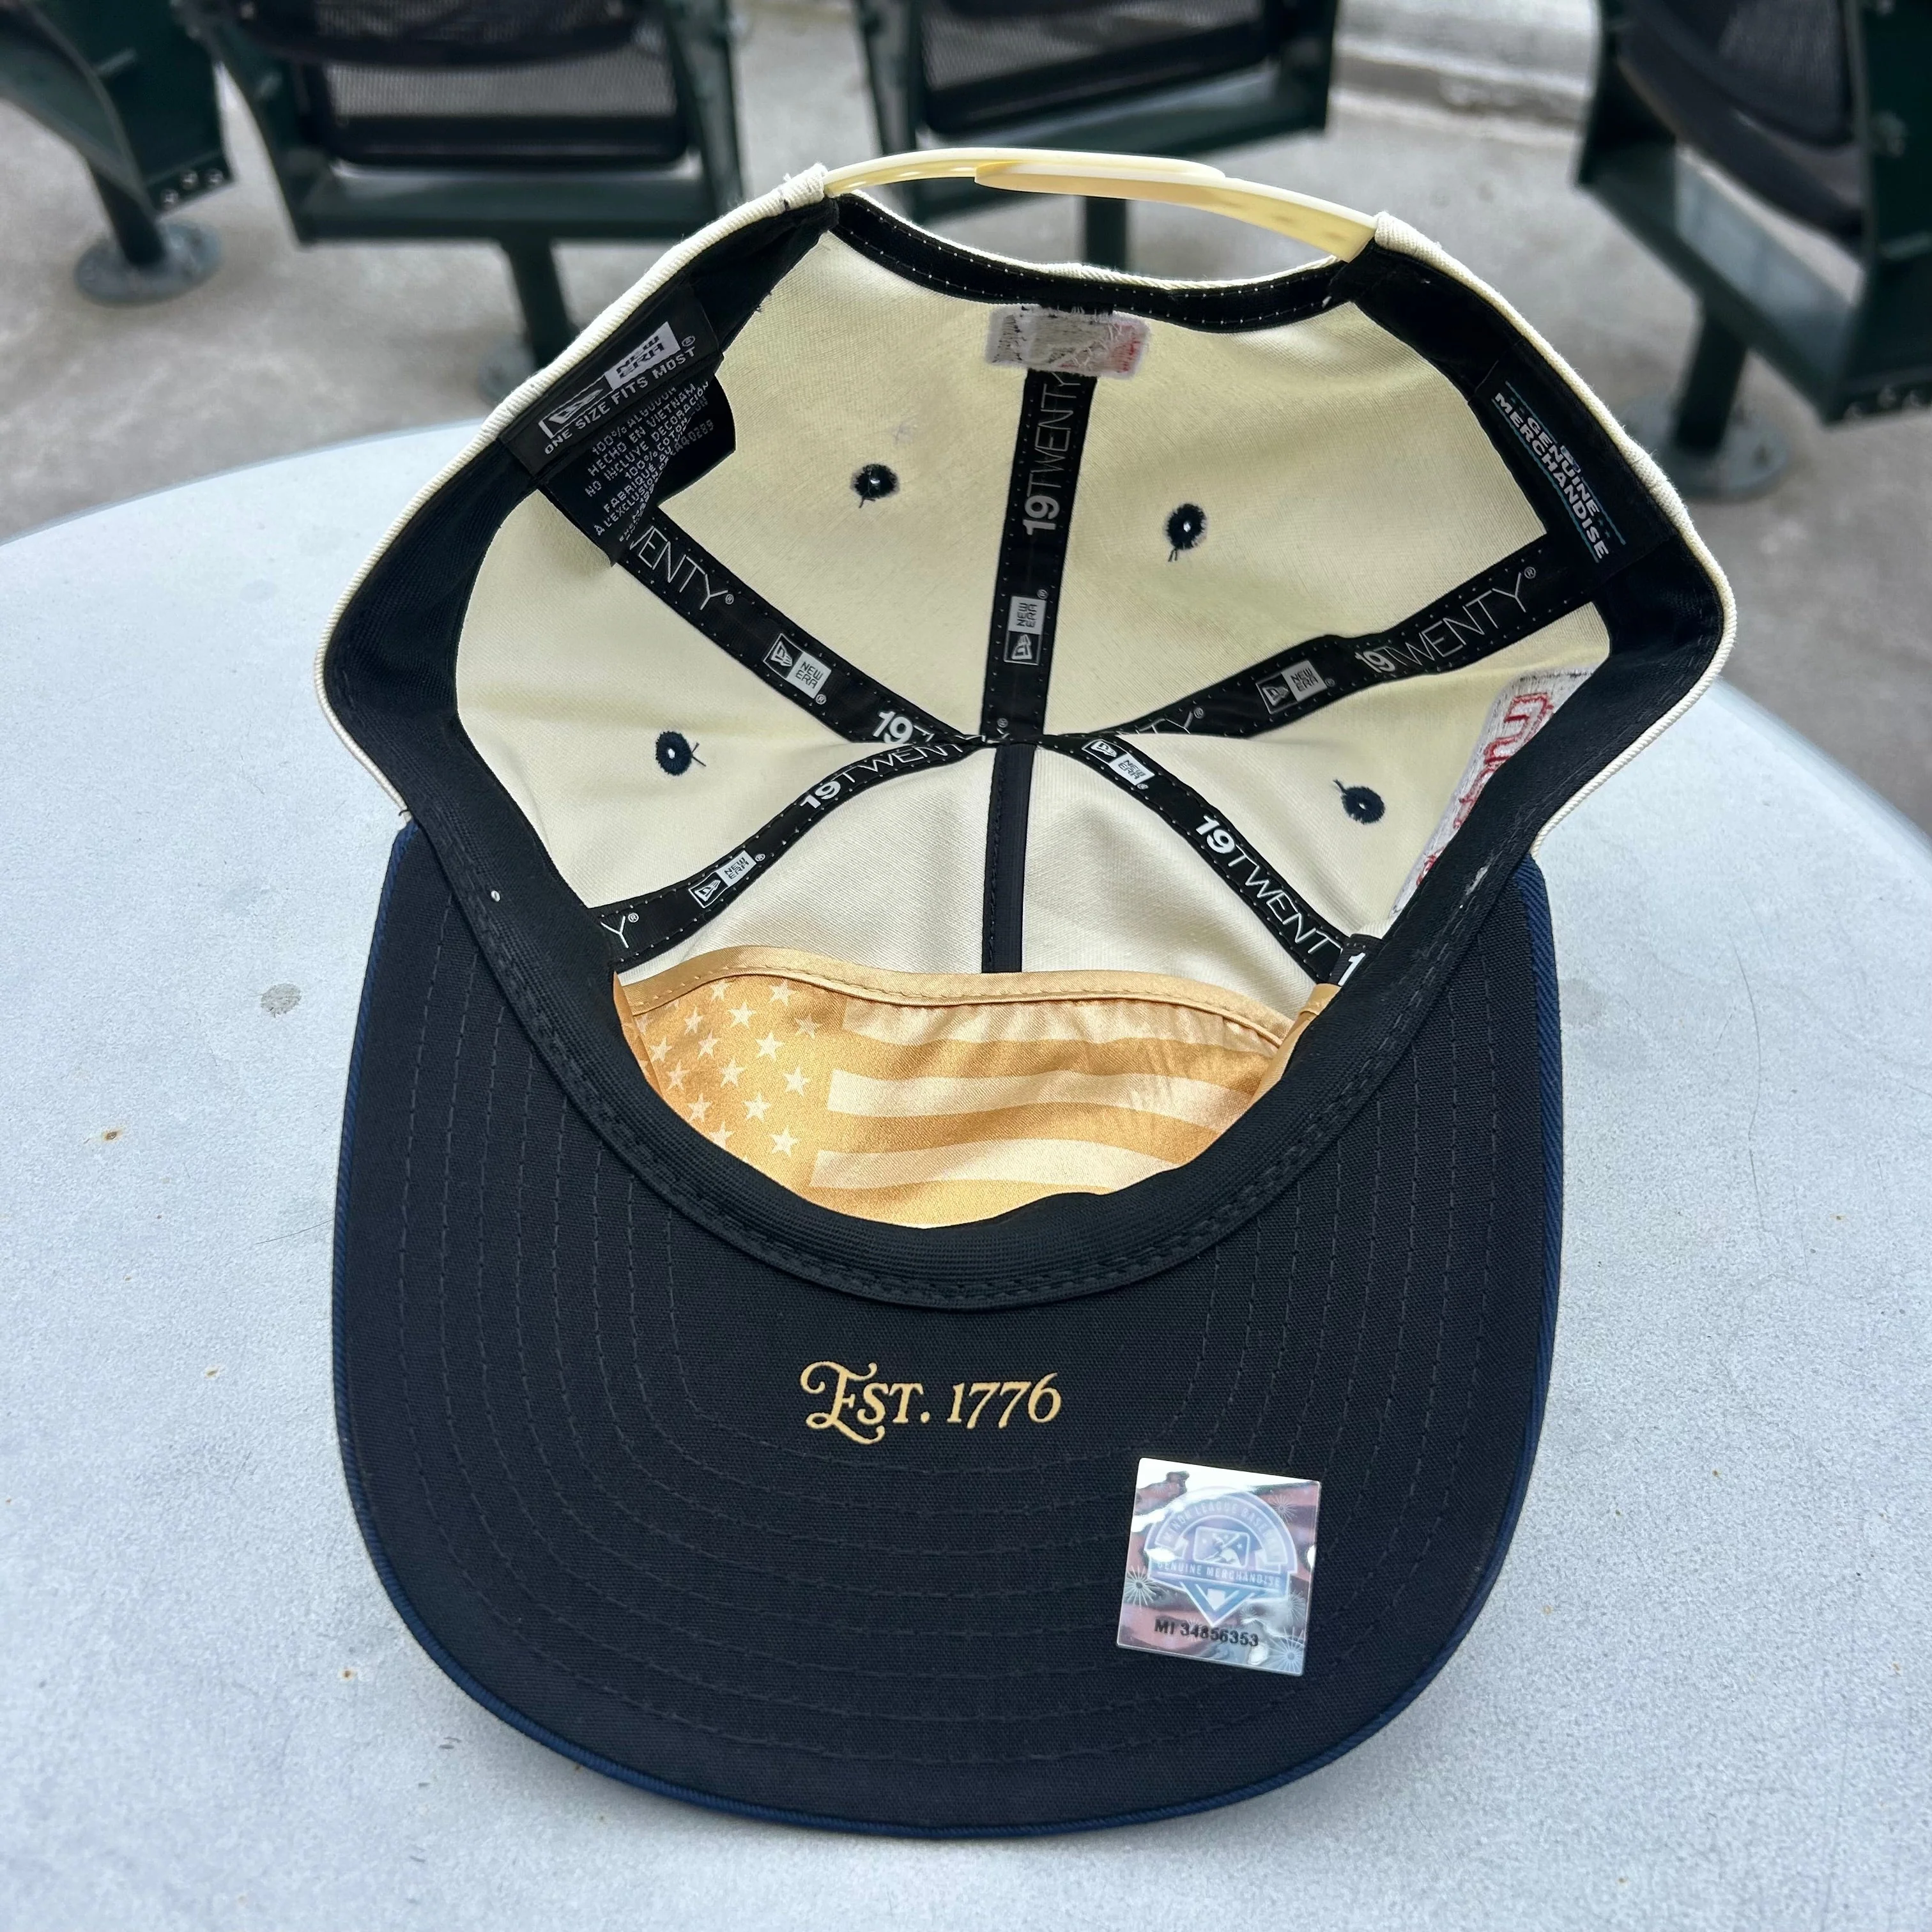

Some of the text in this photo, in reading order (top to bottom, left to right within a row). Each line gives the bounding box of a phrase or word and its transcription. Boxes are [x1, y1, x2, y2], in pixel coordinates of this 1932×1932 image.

[617, 335, 659, 374] NEW
[620, 342, 664, 378] ERA
[544, 346, 695, 454] ONE SIZE FITS MOST
[587, 441, 627, 476] HECHO
[629, 426, 646, 443] EN
[646, 383, 696, 427] VIETNAM
[592, 426, 627, 456] 100%
[625, 451, 658, 479] 100%
[657, 417, 687, 452] COTON
[585, 480, 602, 496] NO
[604, 441, 648, 480] INCLUYE
[1494, 392, 1609, 559] MERCHANDISE
[1528, 417, 1600, 516] GENUINE
[603, 463, 656, 512] FABRIQUÉ
[1016, 602, 1027, 627] NEW
[1025, 604, 1037, 627] ERA
[795, 670, 818, 689] ERA
[801, 661, 824, 681] NEW
[1291, 667, 1313, 684] NEW
[1296, 676, 1319, 691] ERA
[1118, 763, 1140, 779] ERA
[1124, 760, 1146, 776] NEW
[724, 857, 746, 875] NEW
[728, 861, 749, 879] ERA
[1196, 815, 1342, 954] 19TWENT
[947, 1372, 1062, 1429] 1776
[1180, 1621, 1259, 1646] 34856353
